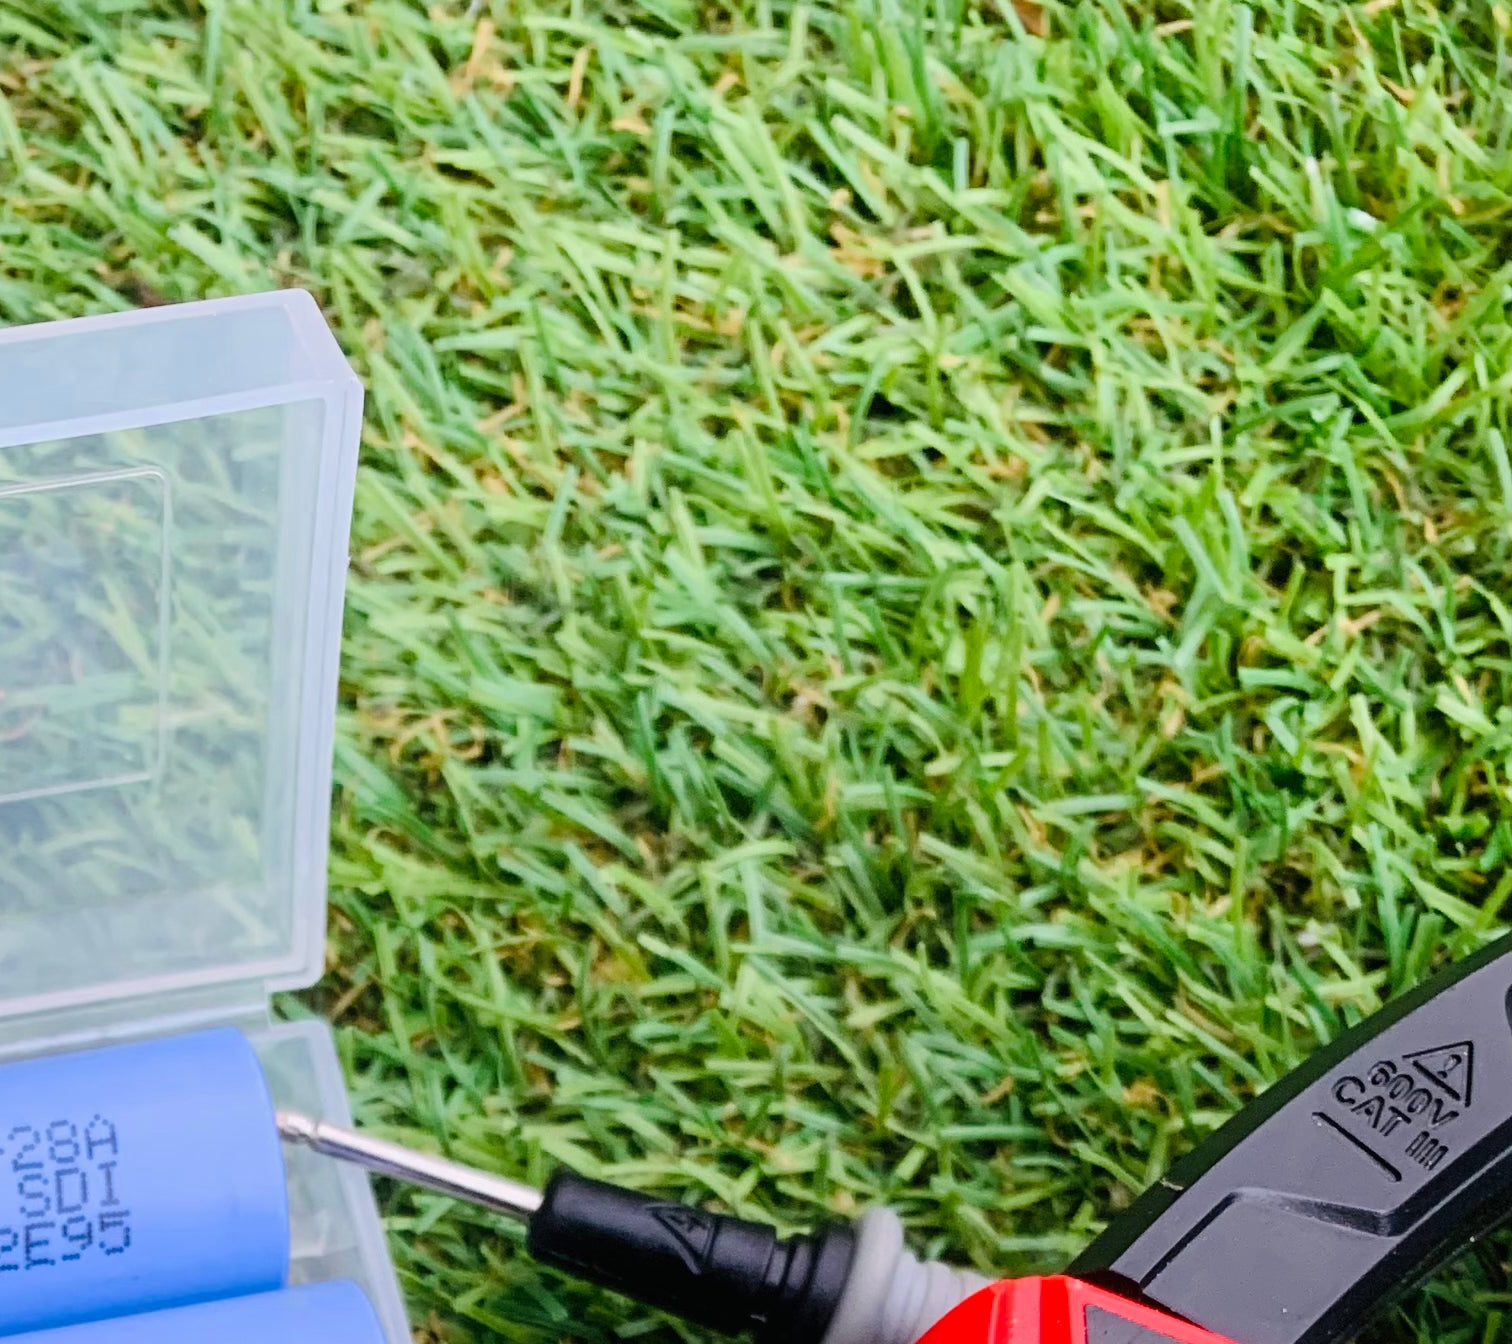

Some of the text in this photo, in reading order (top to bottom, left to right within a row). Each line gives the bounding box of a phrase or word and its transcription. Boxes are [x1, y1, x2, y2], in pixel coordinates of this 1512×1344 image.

[1331, 1075, 1412, 1138] CAT
[1367, 1060, 1460, 1129] 600V
[18, 1161, 120, 1218] SDI
